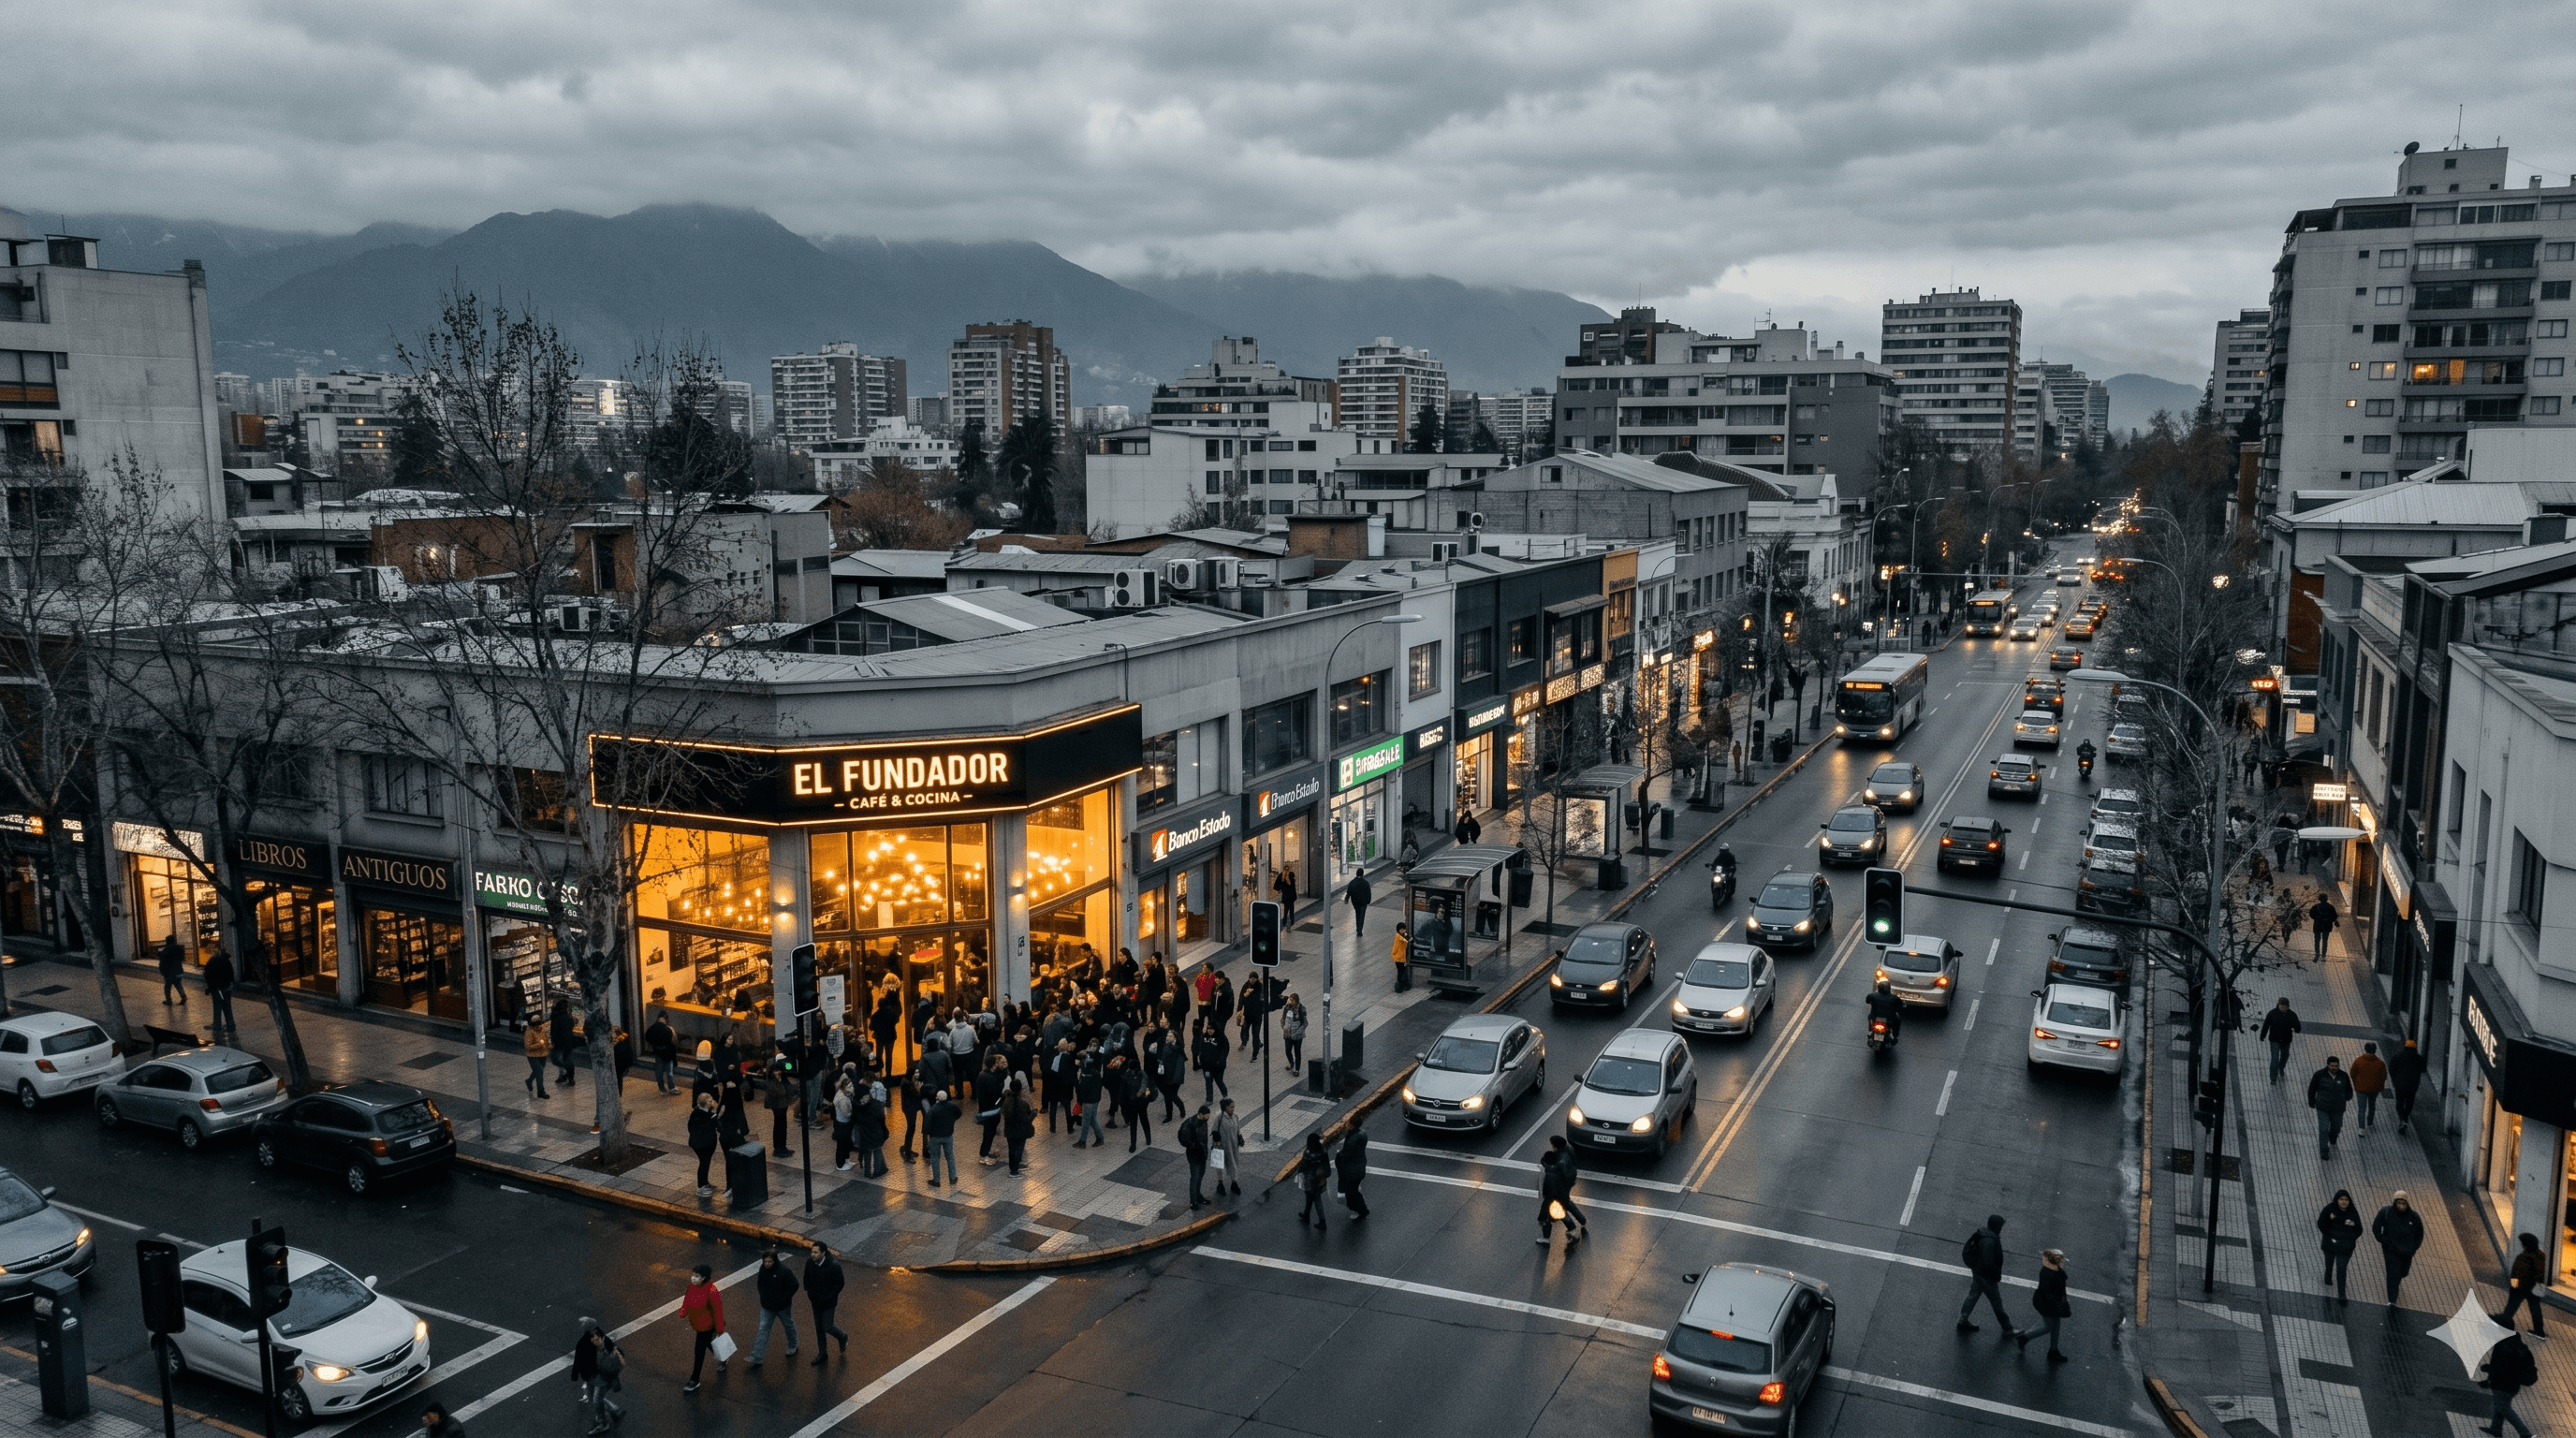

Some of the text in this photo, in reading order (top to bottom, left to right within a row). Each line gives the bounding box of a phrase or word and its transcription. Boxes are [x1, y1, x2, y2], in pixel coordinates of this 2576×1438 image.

[794, 752, 1008, 795] EL FUNDADOR
[849, 791, 960, 809] CAFÉ & COCINA
[1168, 810, 1231, 852] Banco Estado
[239, 839, 307, 870] LIBROS
[344, 855, 447, 890] ANTIGUOS
[475, 872, 533, 898] FARKO
